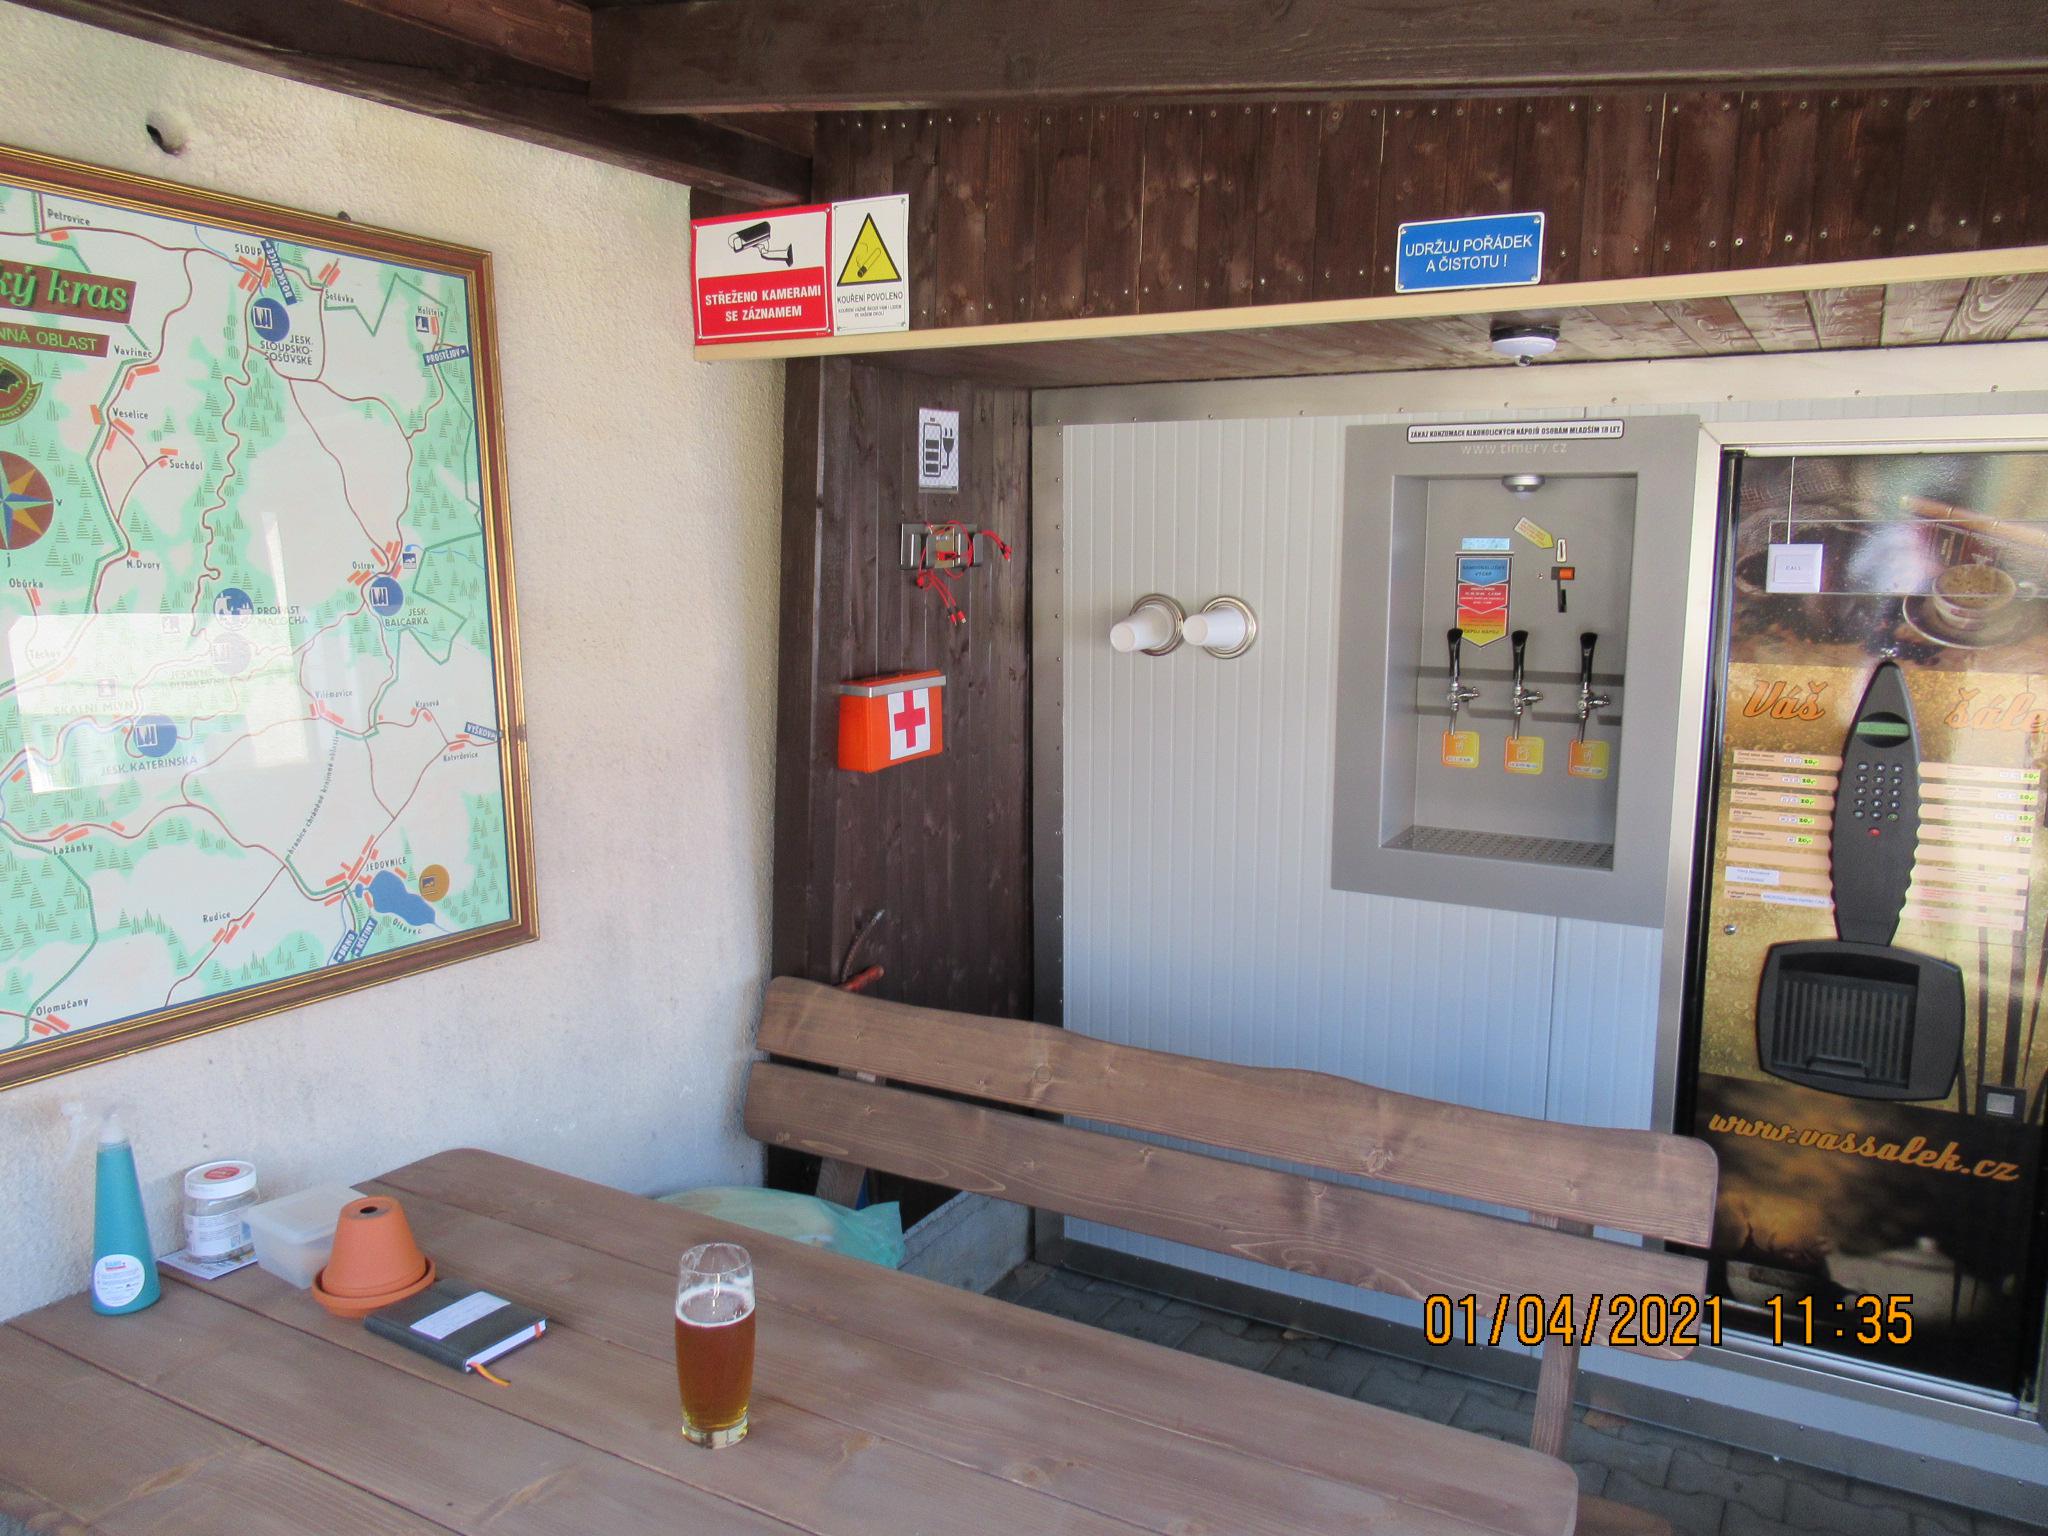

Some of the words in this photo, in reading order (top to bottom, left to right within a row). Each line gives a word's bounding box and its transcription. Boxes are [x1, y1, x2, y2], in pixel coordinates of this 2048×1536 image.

[235, 243, 262, 256] SLOUP
[1405, 238, 1460, 257] UDRŽUJ
[1463, 234, 1533, 252] POŘÁDEK
[1426, 259, 1435, 273] A
[1438, 254, 1499, 272] ČISTOTU
[266, 247, 293, 299] BOSKOVICE
[48, 269, 128, 313] kras
[705, 289, 758, 306] STŘEŽENO
[762, 285, 821, 301] KAMERAMI
[837, 291, 865, 304] KOUŘENÍ
[866, 290, 903, 302] POVOLENO
[725, 310, 739, 322] SE
[742, 305, 802, 321] ZÁZNAMEM
[36, 332, 97, 352] OBLAST
[113, 344, 153, 359] Vavřinec
[112, 408, 149, 420] Veselice
[1410, 430, 1428, 438] ZÁKAZ
[1429, 429, 1465, 437] KONZUMACE
[1466, 427, 1515, 437] ALKOHOLICKÝCH
[1516, 426, 1540, 435] NÁPOJŮ
[1541, 426, 1568, 435] OSOBÁM
[1569, 425, 1600, 434] MLADŠÍM
[169, 459, 203, 471] Suchdol
[352, 561, 375, 570] Ostrov
[385, 616, 429, 627] BALCARKA
[1743, 680, 1829, 722] Váš
[53, 842, 94, 857] Lažánky
[366, 856, 407, 872] JEDOVNICE
[203, 911, 231, 924] Rudice
[338, 933, 356, 956] BRNO
[35, 997, 89, 1017] Olomučany
[1708, 1113, 2021, 1182] www.vassalek.cz
